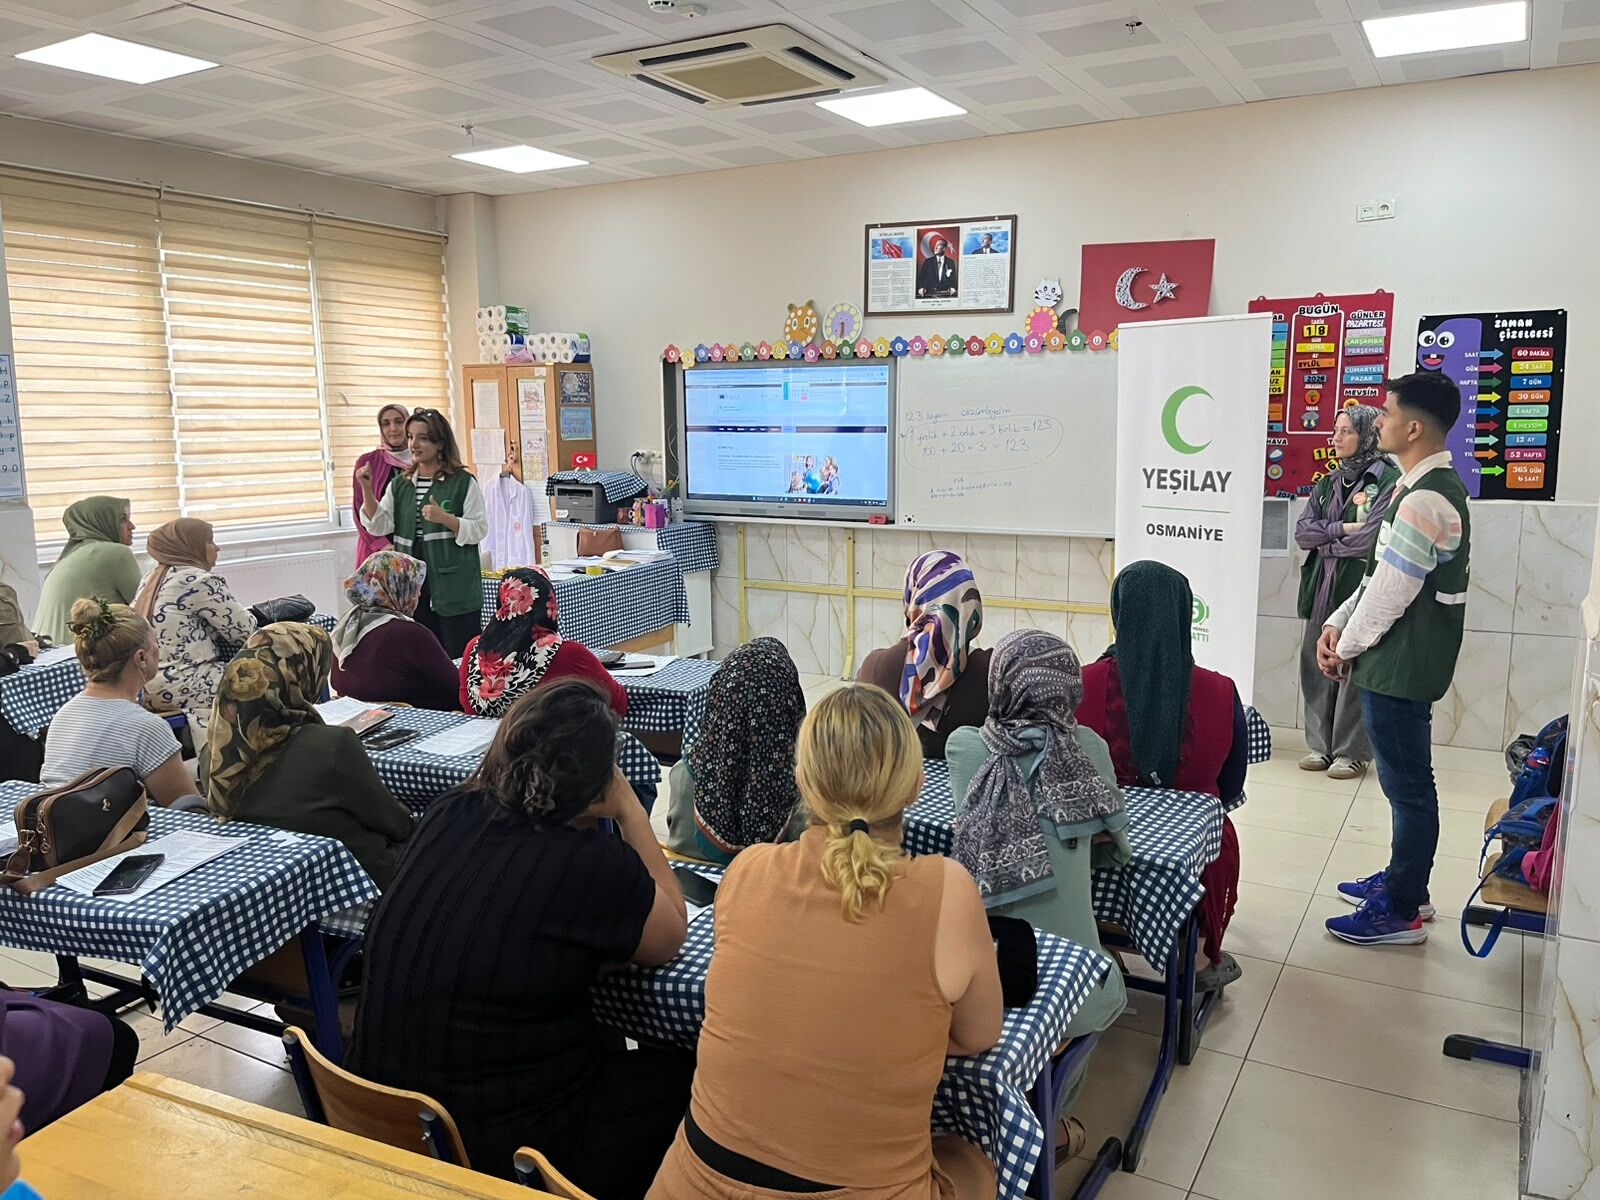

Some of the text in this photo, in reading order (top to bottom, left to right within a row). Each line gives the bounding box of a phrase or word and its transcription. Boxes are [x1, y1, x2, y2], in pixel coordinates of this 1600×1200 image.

[1299, 303, 1338, 314] BUGÜN
[1351, 311, 1384, 319] GÜNLER
[1494, 319, 1532, 328] ZAMAN
[1306, 326, 1326, 336] 18
[1499, 327, 1554, 341] ÇİZELGESİ
[1346, 338, 1383, 346] ÇARŞAMBA
[1345, 387, 1377, 396] MEVSİM
[1033, 419, 1052, 432] 123
[951, 442, 966, 454] 20
[1006, 439, 1031, 453] 123
[1146, 521, 1224, 542] OSMANİYE
